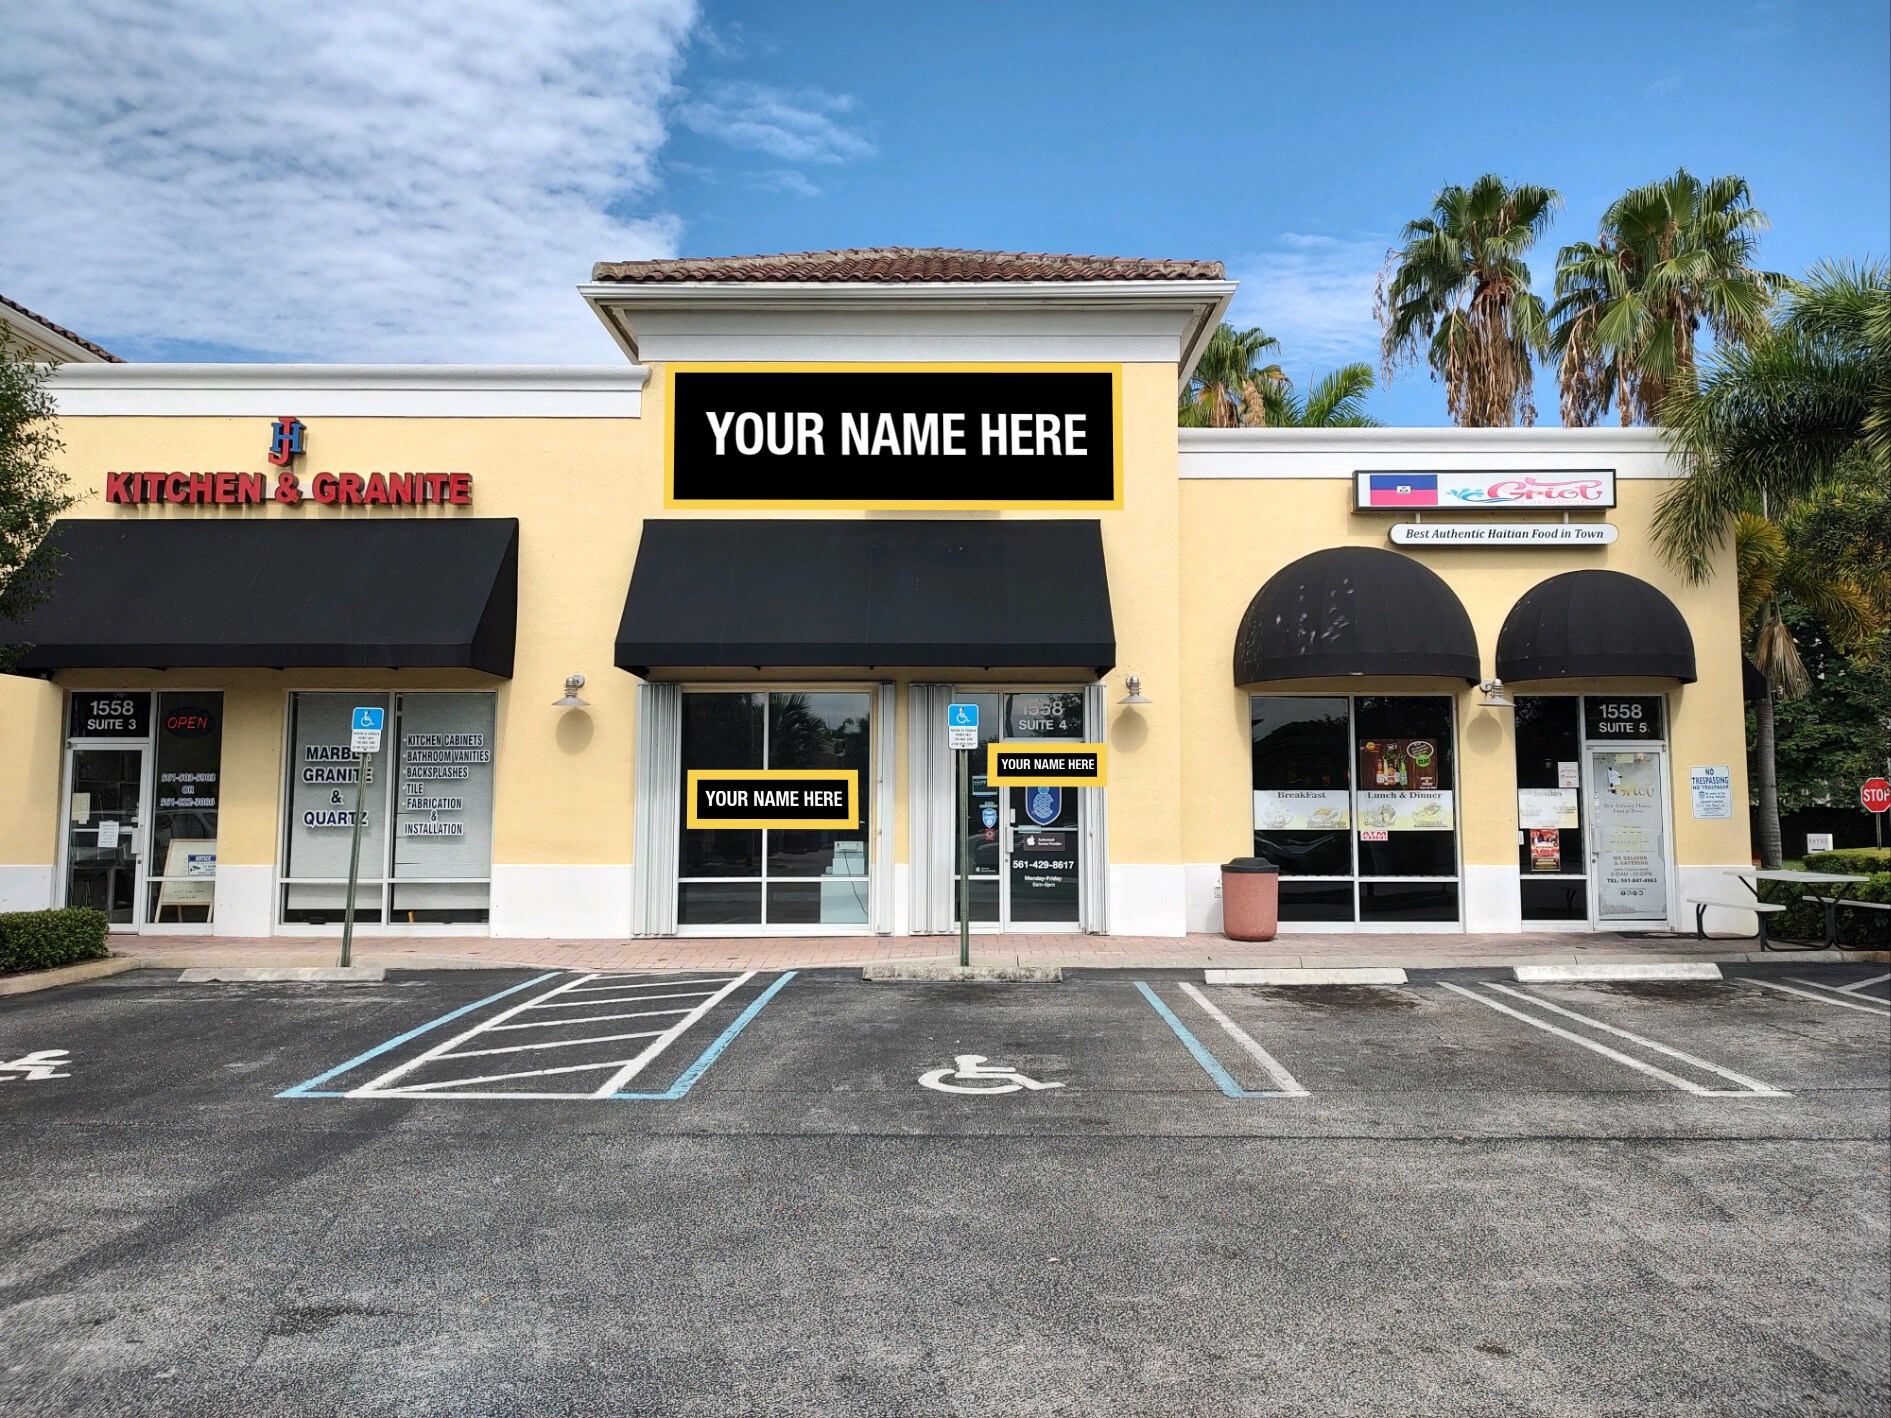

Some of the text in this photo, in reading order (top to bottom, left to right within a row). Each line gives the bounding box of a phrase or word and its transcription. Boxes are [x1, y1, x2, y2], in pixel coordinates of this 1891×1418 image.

[105, 472, 473, 505] KITCHEN & GRANITE
[1487, 476, 1604, 501] Griot
[1405, 528, 1604, 540] Best Authentic Haitian Food in Town
[90, 700, 134, 716] 1558
[1599, 703, 1642, 719] 1558
[87, 719, 137, 730] SUITE 3
[167, 716, 208, 730] OPEN
[1018, 719, 1068, 730] SUITE 4
[1599, 722, 1648, 733] SUITE 5
[407, 734, 483, 747] KITCHEN CABINETS
[406, 750, 490, 763] BATHROOM VANITIES
[302, 767, 373, 783] GRANITE
[406, 766, 469, 779] BACKSPLASHES
[1705, 768, 1715, 776] NO
[1691, 777, 1729, 785] TRESPASSING
[181, 785, 195, 795] OR
[407, 783, 424, 795] TILE
[1277, 791, 1326, 799] BreakFast
[1367, 791, 1397, 799] Lunch
[1409, 791, 1443, 799] Dinner
[1863, 788, 1890, 802] STOP
[330, 789, 344, 804] &
[406, 798, 463, 810] FABRICATION
[303, 810, 368, 828] QUARTZ
[430, 810, 438, 822] &
[405, 823, 463, 836] INSTALLATION
[1012, 860, 1075, 869] 561-429-8617
